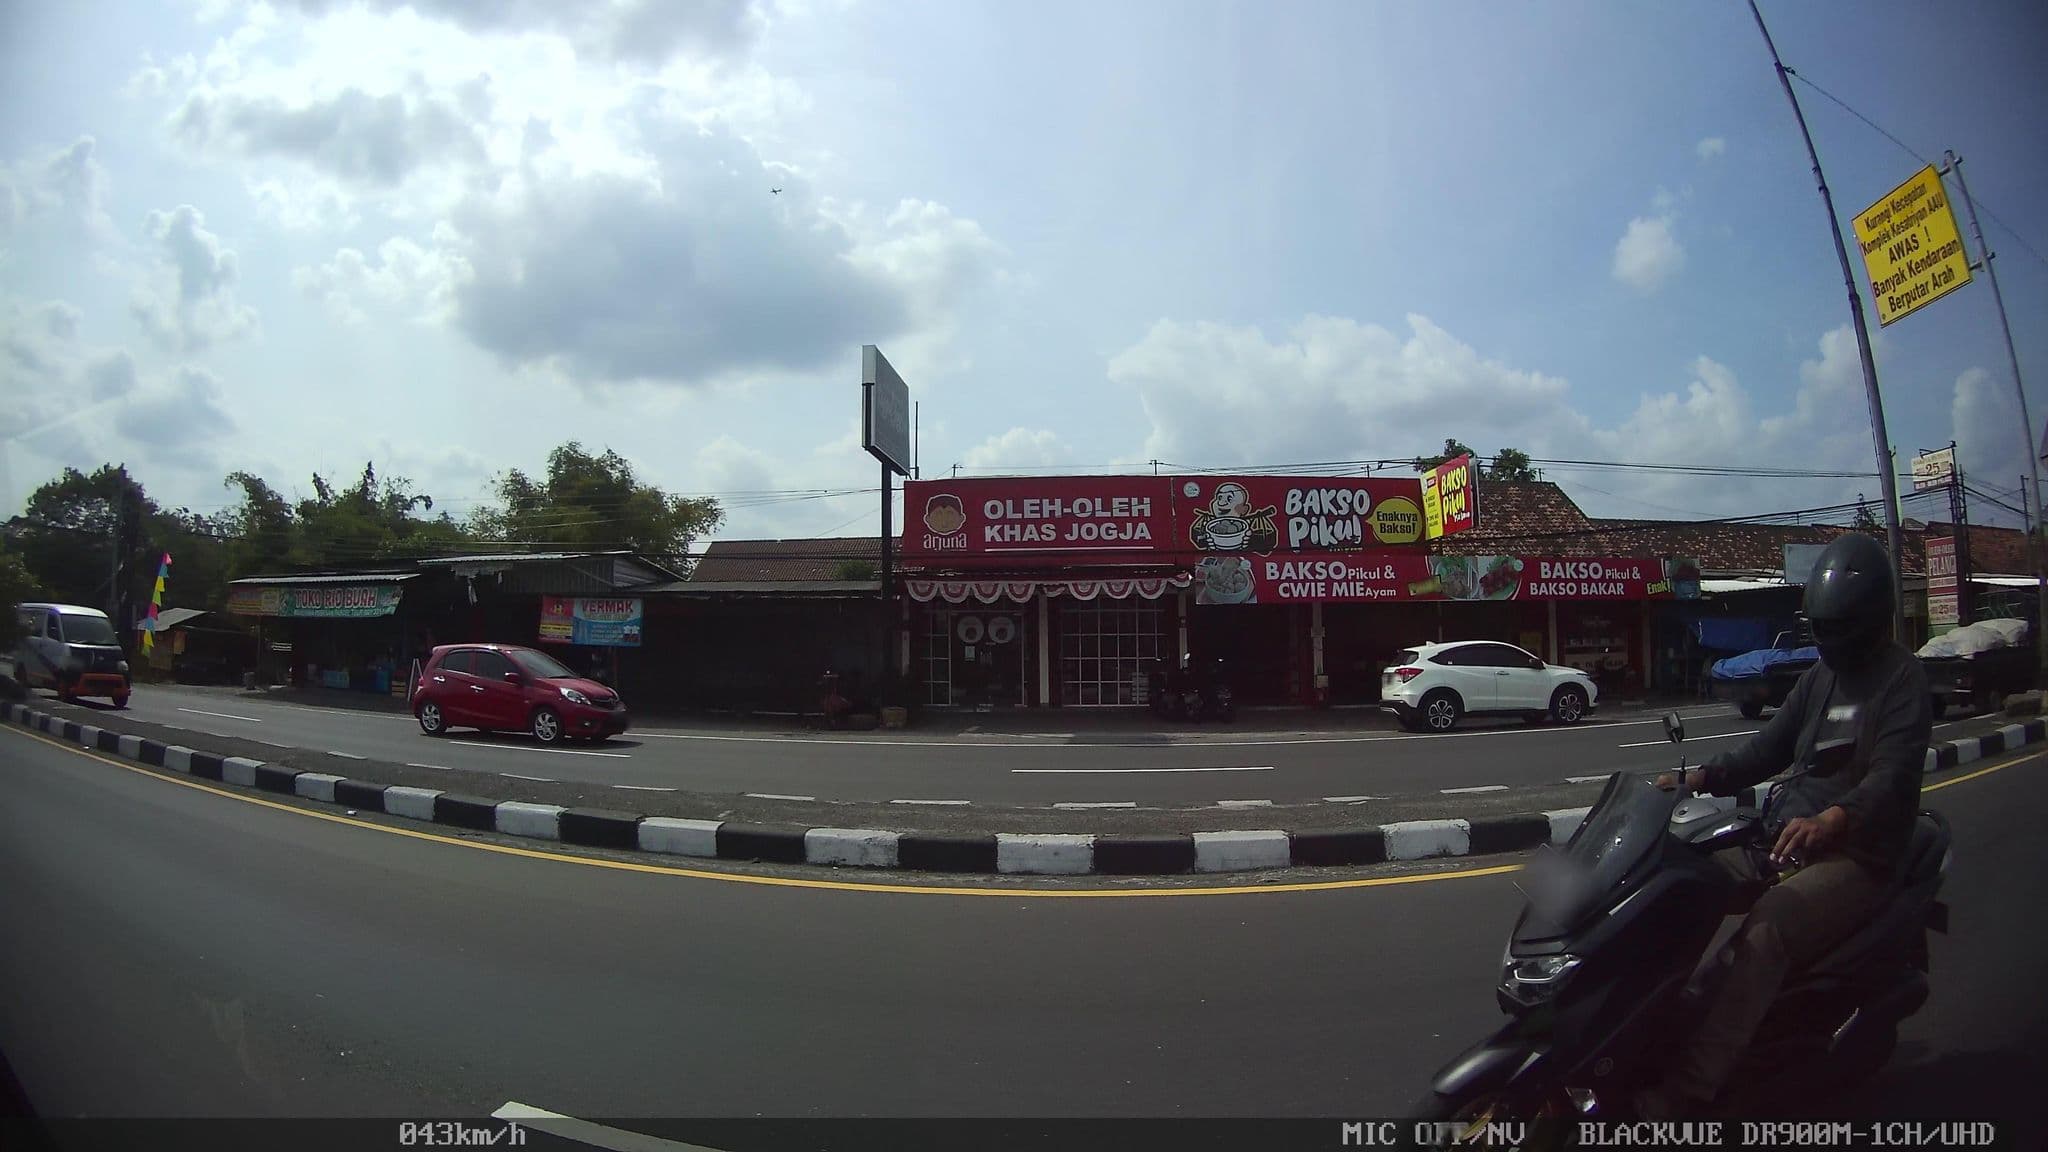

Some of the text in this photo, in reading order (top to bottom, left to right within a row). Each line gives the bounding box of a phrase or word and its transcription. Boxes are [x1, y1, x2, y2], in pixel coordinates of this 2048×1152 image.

[1865, 183, 1927, 233] Kurangi Kecepatan
[1861, 230, 1891, 256] Komplek
[1926, 191, 1945, 215] AAU
[1888, 233, 1919, 264] AWAS
[1872, 240, 1960, 298] Banyak Kendaraan
[1888, 264, 1955, 313] Berputar Arah
[1926, 463, 1940, 476] 25
[1441, 465, 1467, 496] BAKSO
[984, 497, 1152, 520] OLEH-OLEH
[1285, 488, 1370, 516] BAKSO
[1376, 510, 1418, 526] Enaknya
[985, 522, 1152, 542] KHAS JOGJA
[1380, 522, 1416, 535] Bakso!
[923, 533, 967, 551] arjuna
[1266, 560, 1396, 581] BAKSO Pikul &
[1540, 561, 1641, 580] BAKSO Pikul &
[1278, 582, 1397, 600] CWIE MIE Ayam
[1529, 582, 1625, 596] BAKSO BAKAR
[1647, 579, 1672, 596] Enak!
[295, 588, 321, 609] TOKO
[345, 587, 378, 608] BUAH
[581, 600, 634, 614] VERMAK
